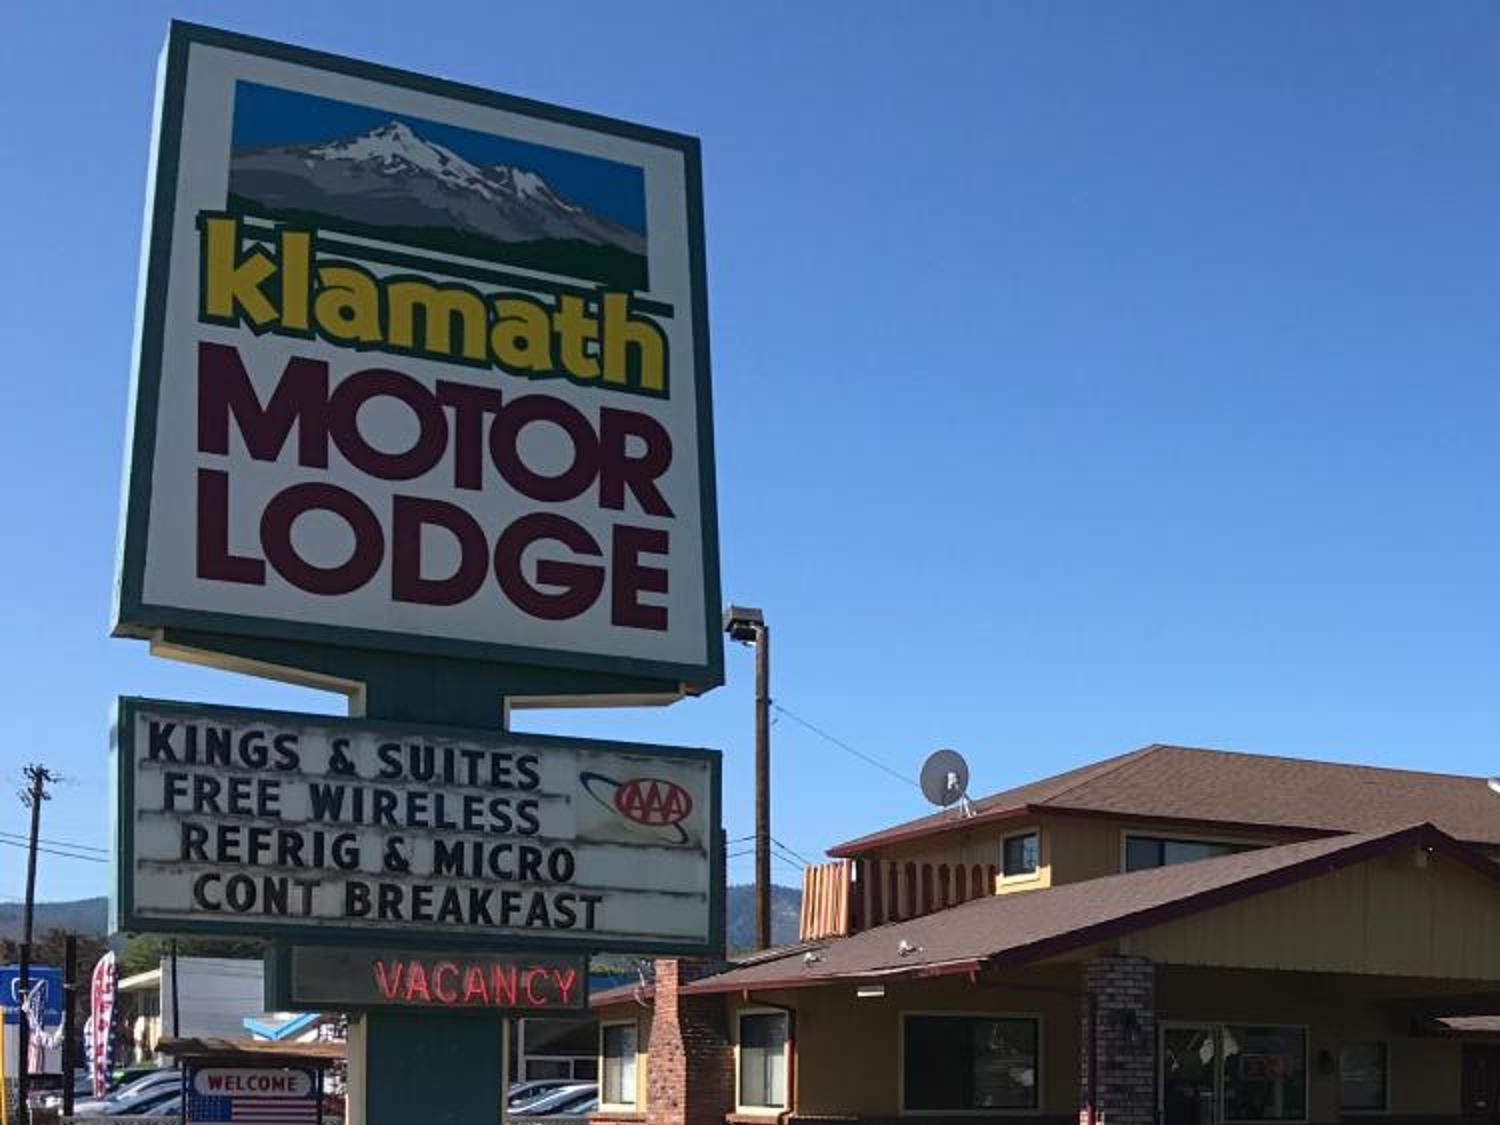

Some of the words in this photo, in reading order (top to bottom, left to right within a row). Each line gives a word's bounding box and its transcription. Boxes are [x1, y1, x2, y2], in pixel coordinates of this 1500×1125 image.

[200, 212, 668, 395] klamath
[197, 341, 675, 517] MOTOR
[196, 467, 669, 631] LODGE
[148, 721, 301, 771] KINGS
[329, 738, 355, 775] &
[376, 743, 541, 790] SUITES
[163, 771, 283, 818] FREE
[309, 783, 540, 835] WIRELESS
[617, 779, 691, 824] AAA
[180, 821, 361, 871] REFRIG
[383, 835, 410, 873] &
[432, 839, 576, 883] MICRO
[193, 873, 321, 917] CONT
[344, 880, 603, 930] BREAKFAST
[373, 958, 577, 1007] VACANCY
[207, 1074, 298, 1092] WELCOME
